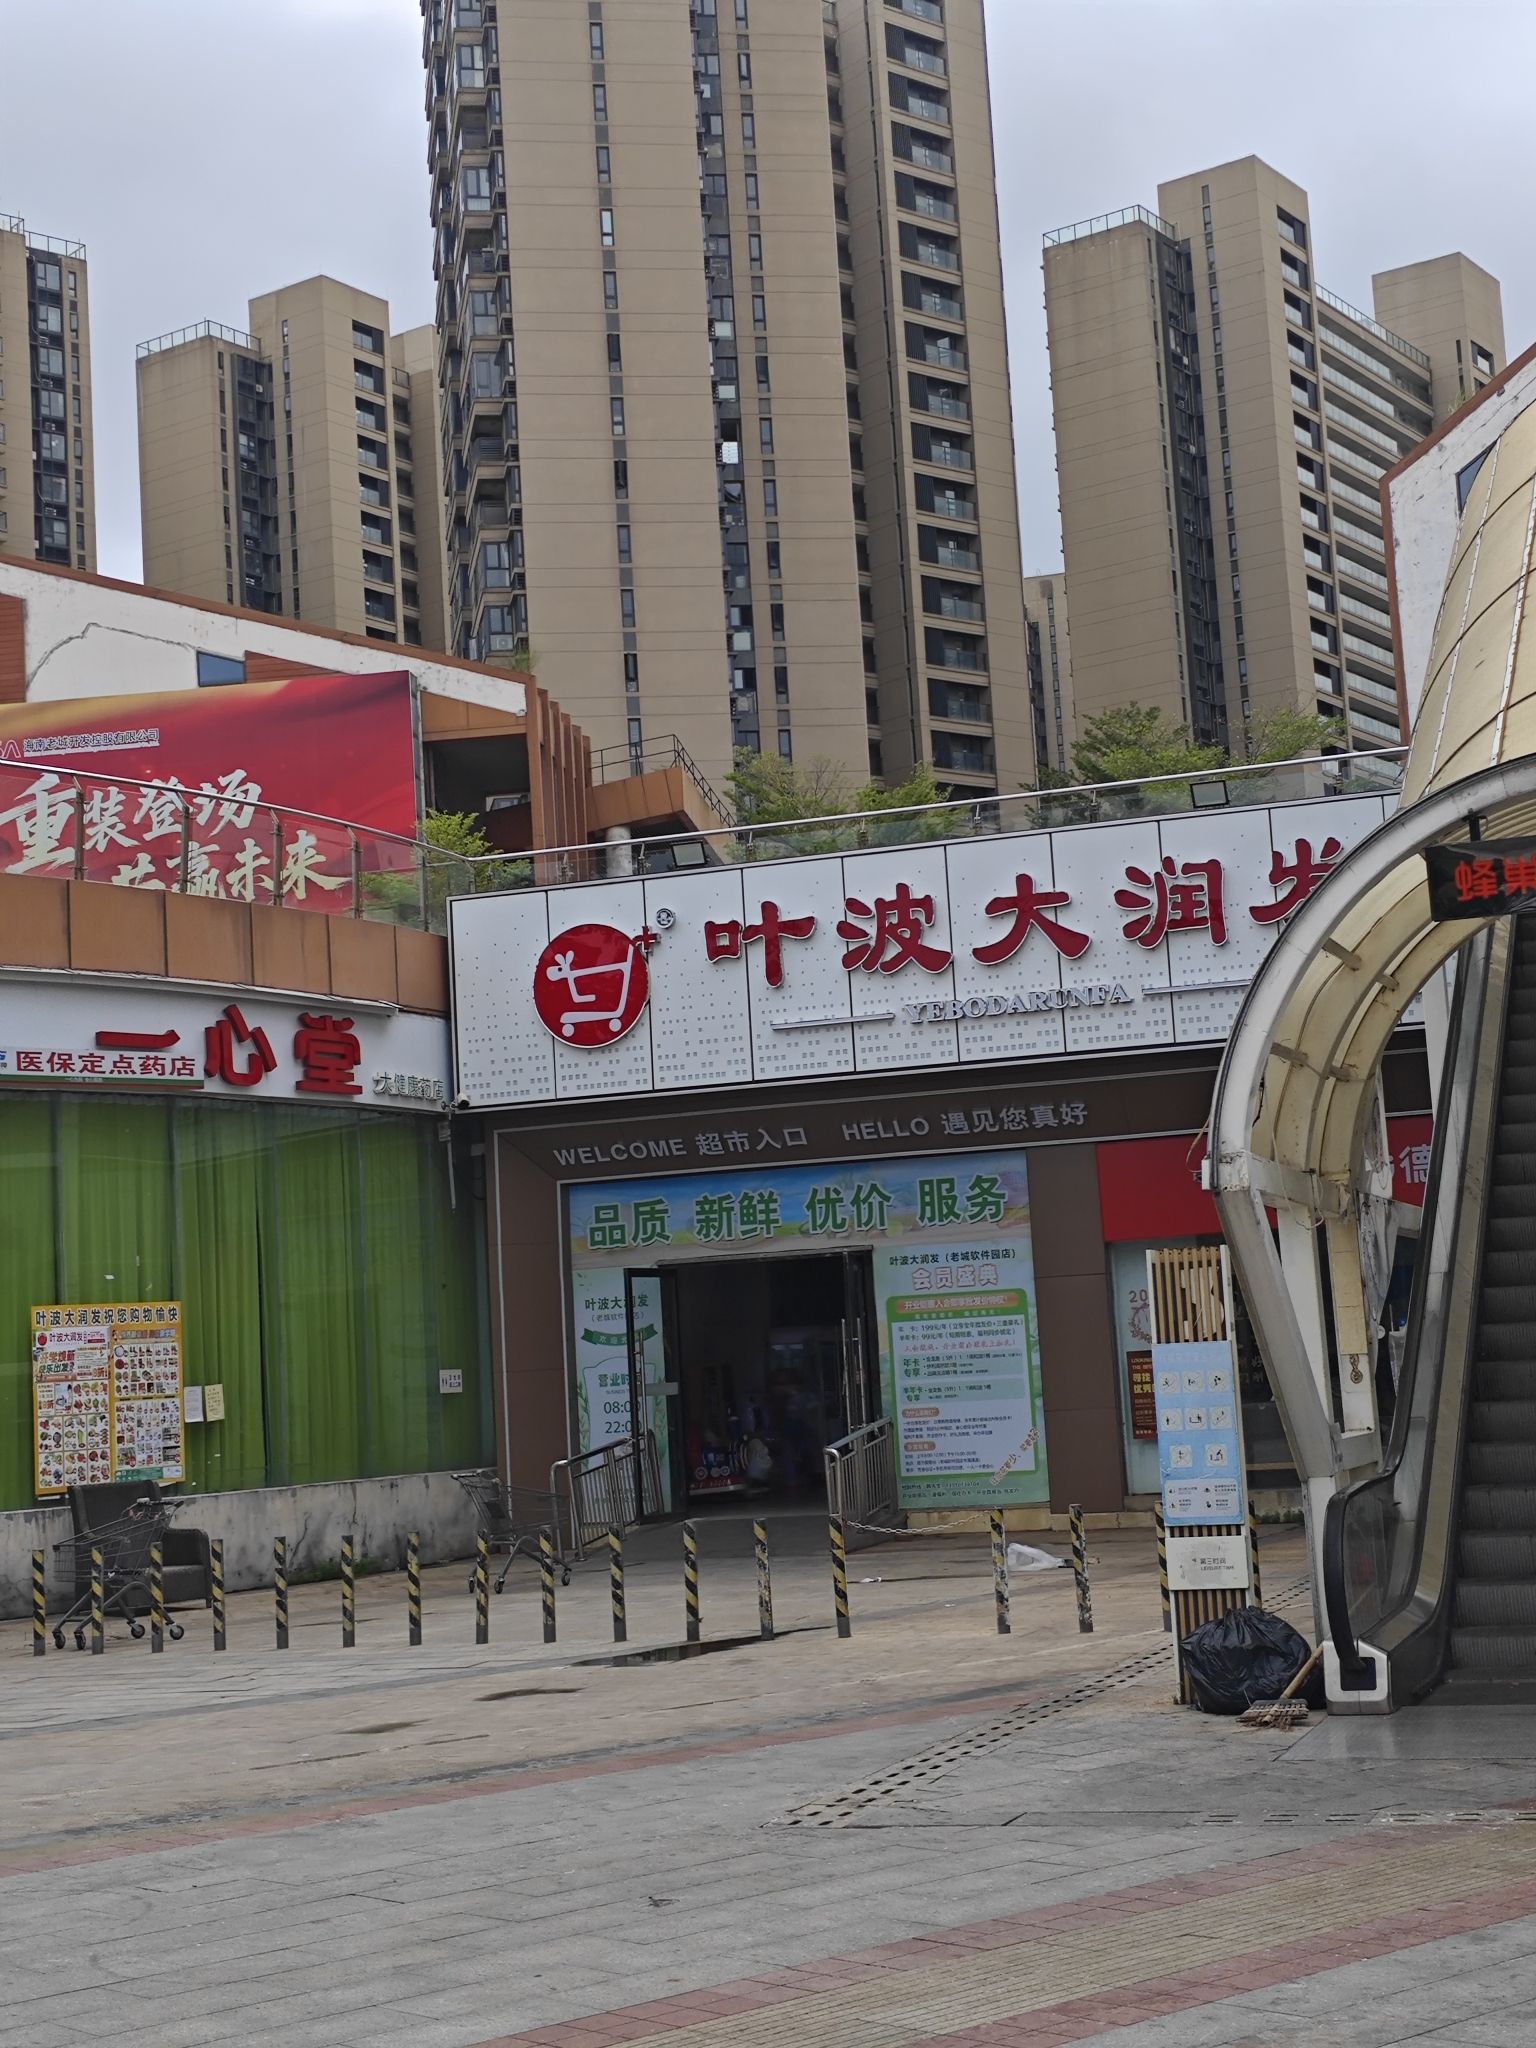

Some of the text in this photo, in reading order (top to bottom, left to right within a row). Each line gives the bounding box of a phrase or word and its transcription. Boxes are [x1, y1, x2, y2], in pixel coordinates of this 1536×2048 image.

[24, 728, 160, 752] 海南老城开发控股有限公司
[0, 769, 262, 874] 重装登场
[904, 982, 1133, 1025] YEBODARUNFA
[16, 1050, 196, 1077] 医保定点药店
[95, 1004, 364, 1096] 一心堂
[373, 1072, 445, 1100] 大健康药店
[554, 1101, 1088, 1167] WELCOME 超市入口 HELLO 遇见您真好
[588, 1173, 1007, 1249] 品质 新鲜 优价 服务
[912, 1263, 998, 1291] 会员盛典
[35, 1307, 178, 1326] 叶波大润发祝您购物愉快
[584, 1294, 649, 1311] 叶波大发
